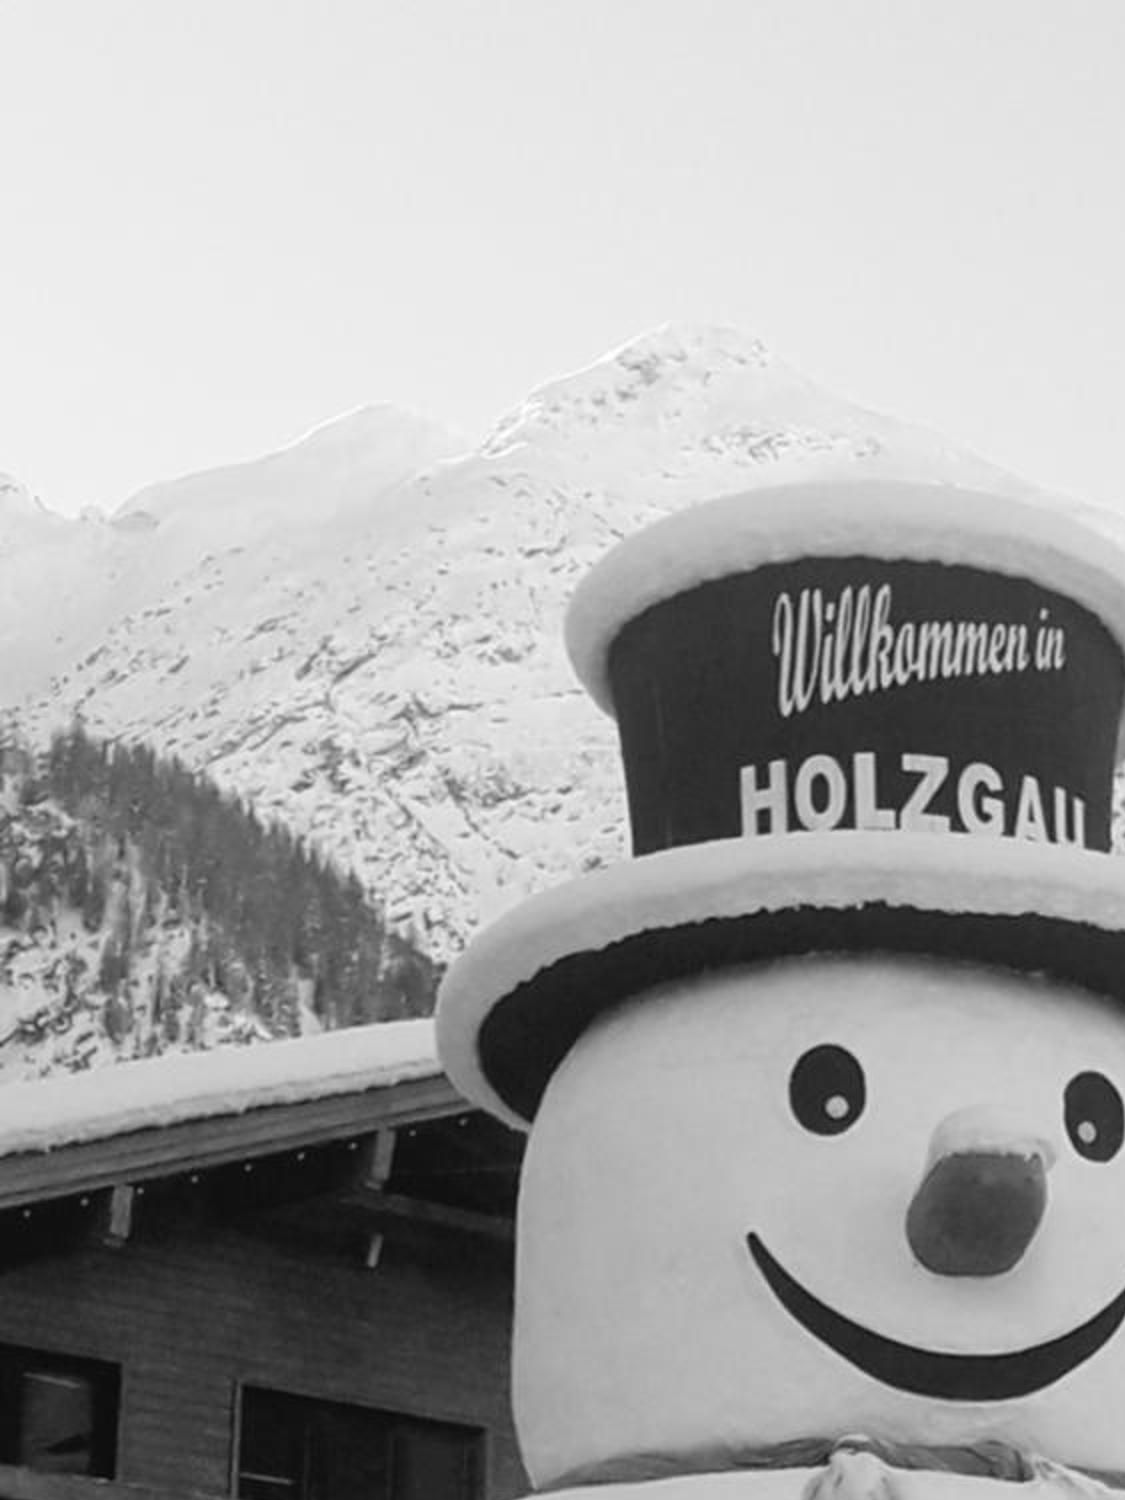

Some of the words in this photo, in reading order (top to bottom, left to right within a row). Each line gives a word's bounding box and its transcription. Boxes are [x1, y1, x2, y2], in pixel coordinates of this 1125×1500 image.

[773, 584, 1029, 717] Willkommen
[1035, 608, 1066, 671] in
[740, 752, 1085, 850] HOLZGAU
